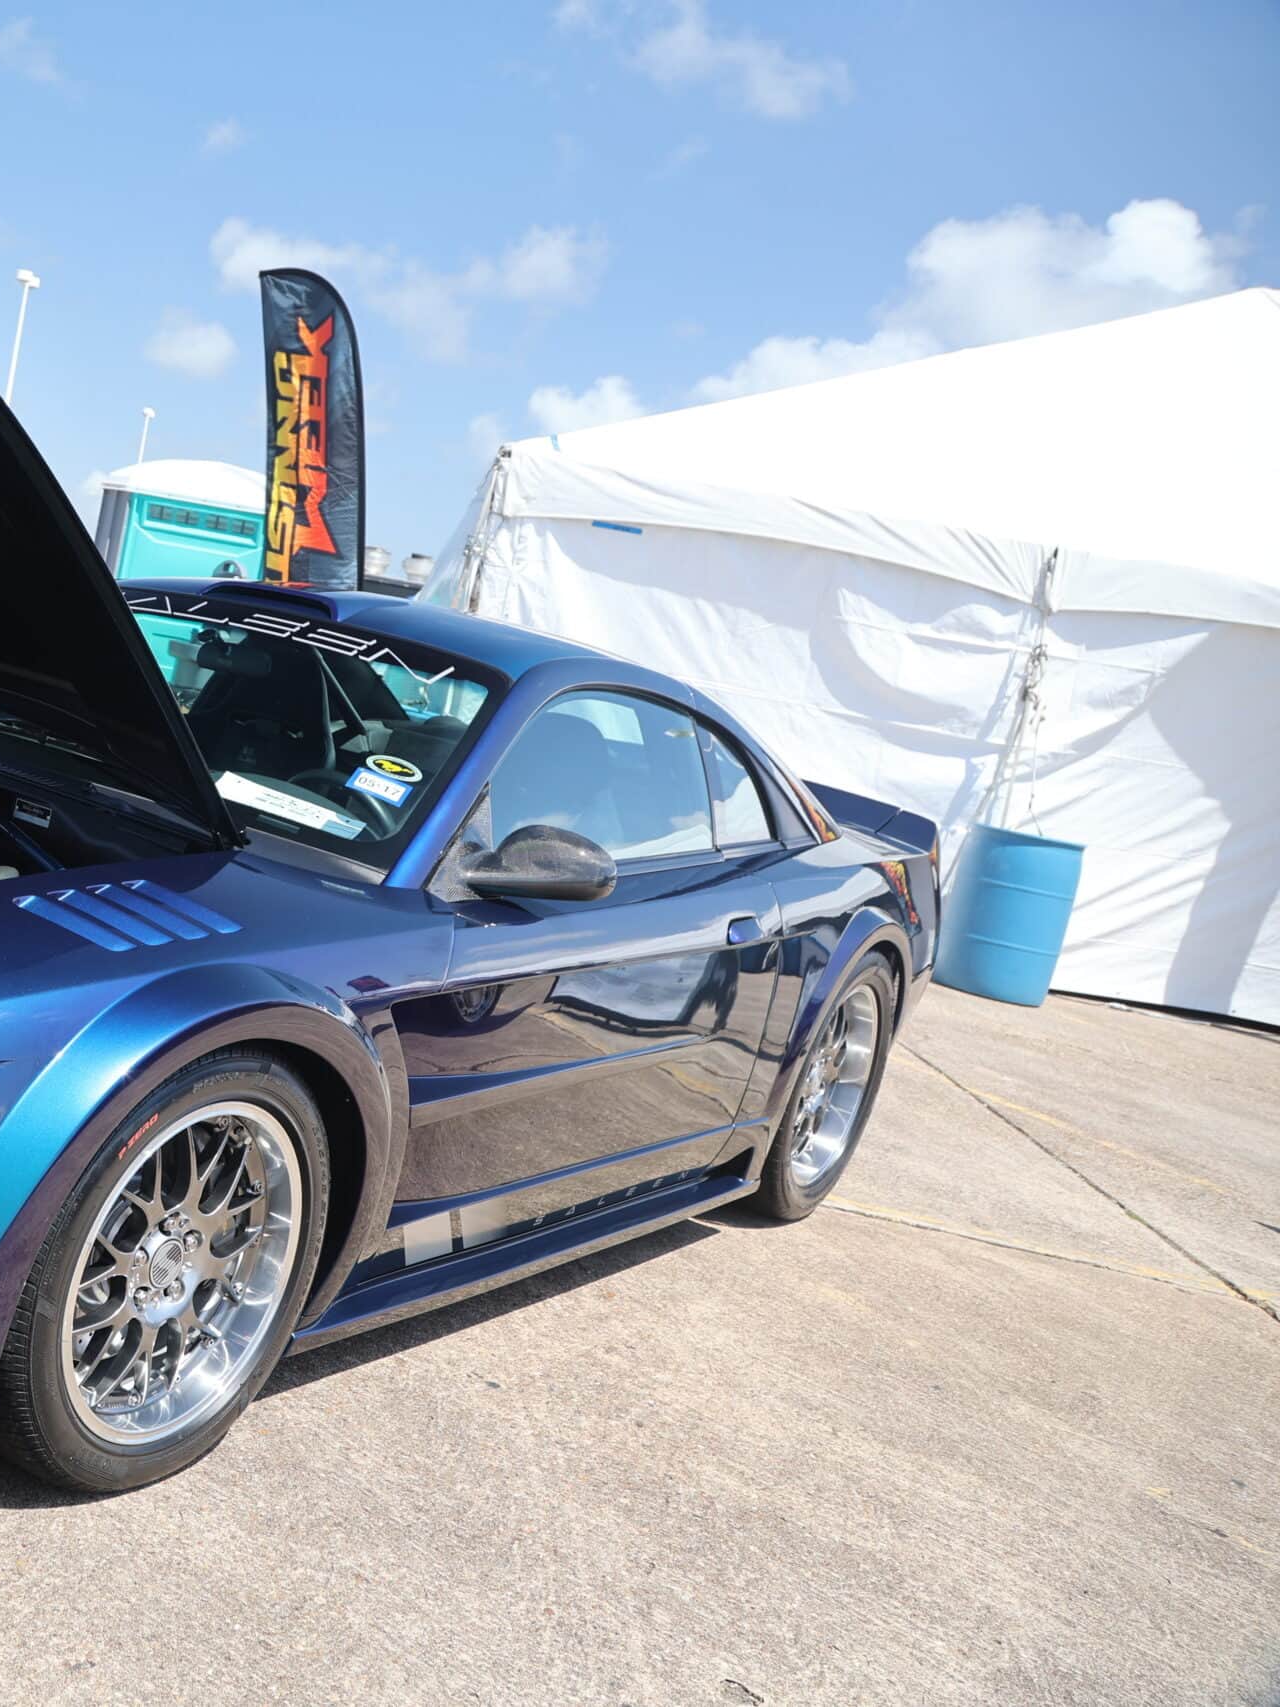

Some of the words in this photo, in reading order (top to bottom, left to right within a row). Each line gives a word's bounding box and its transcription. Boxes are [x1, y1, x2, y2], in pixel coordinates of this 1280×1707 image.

[265, 351, 298, 585] USTANG
[290, 315, 337, 555] WEEK
[122, 592, 456, 685] ALEEN
